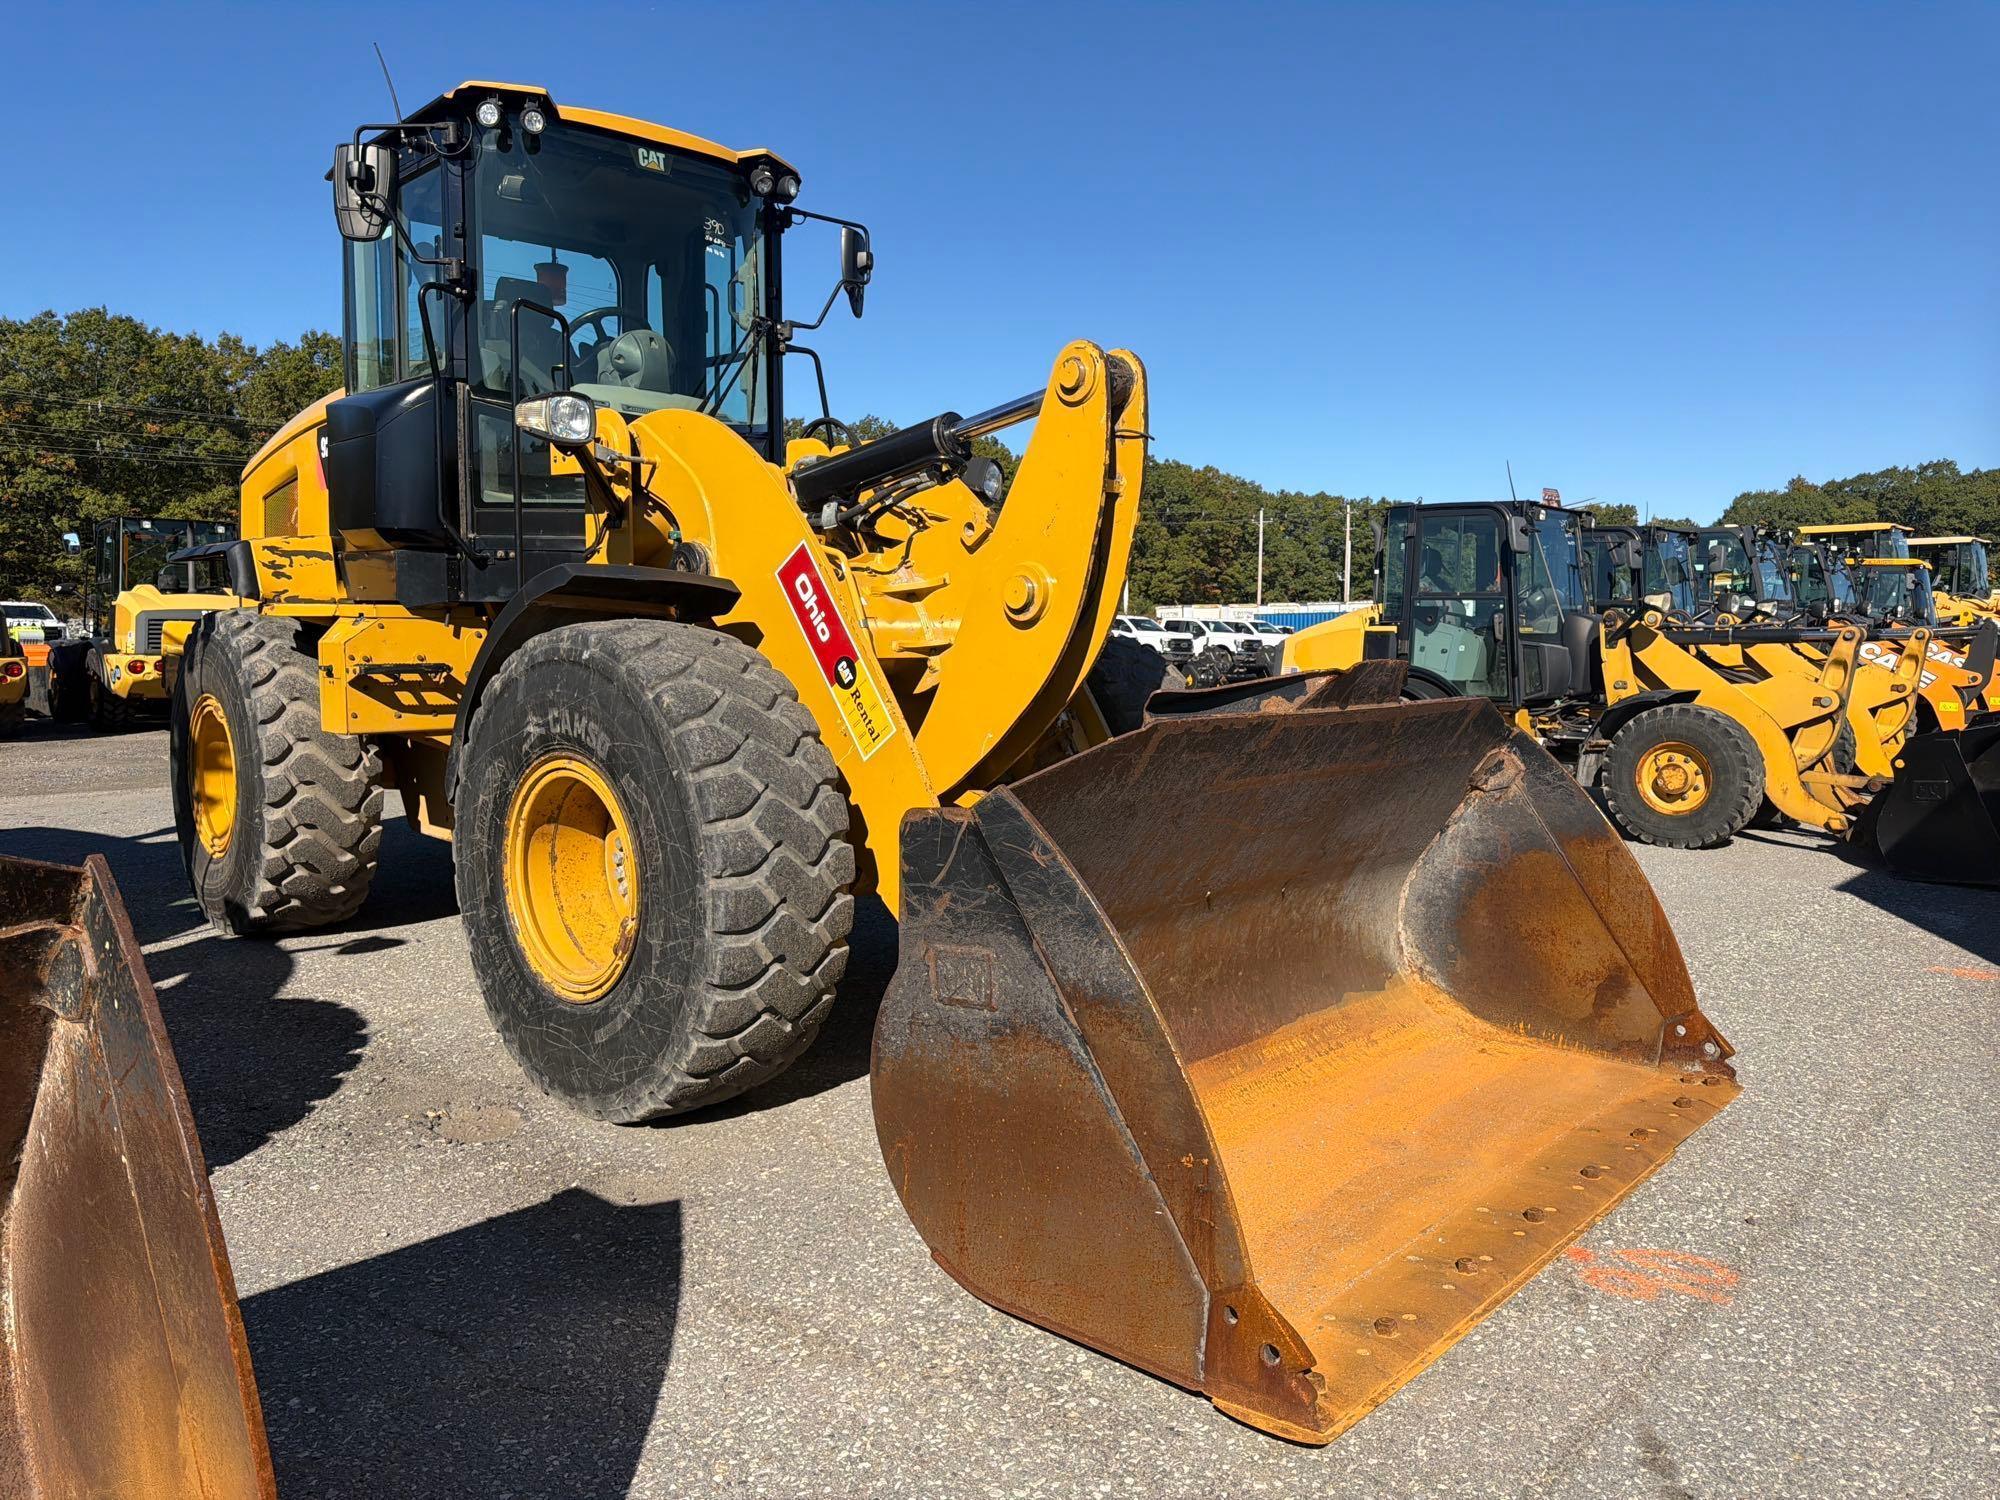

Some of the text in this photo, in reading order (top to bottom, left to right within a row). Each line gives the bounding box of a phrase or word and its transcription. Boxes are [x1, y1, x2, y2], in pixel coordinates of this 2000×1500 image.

[637, 147, 666, 171] CAT
[795, 573, 830, 643] Ohio
[1859, 642, 1938, 689] CAE
[837, 660, 881, 744] CAT Rental
